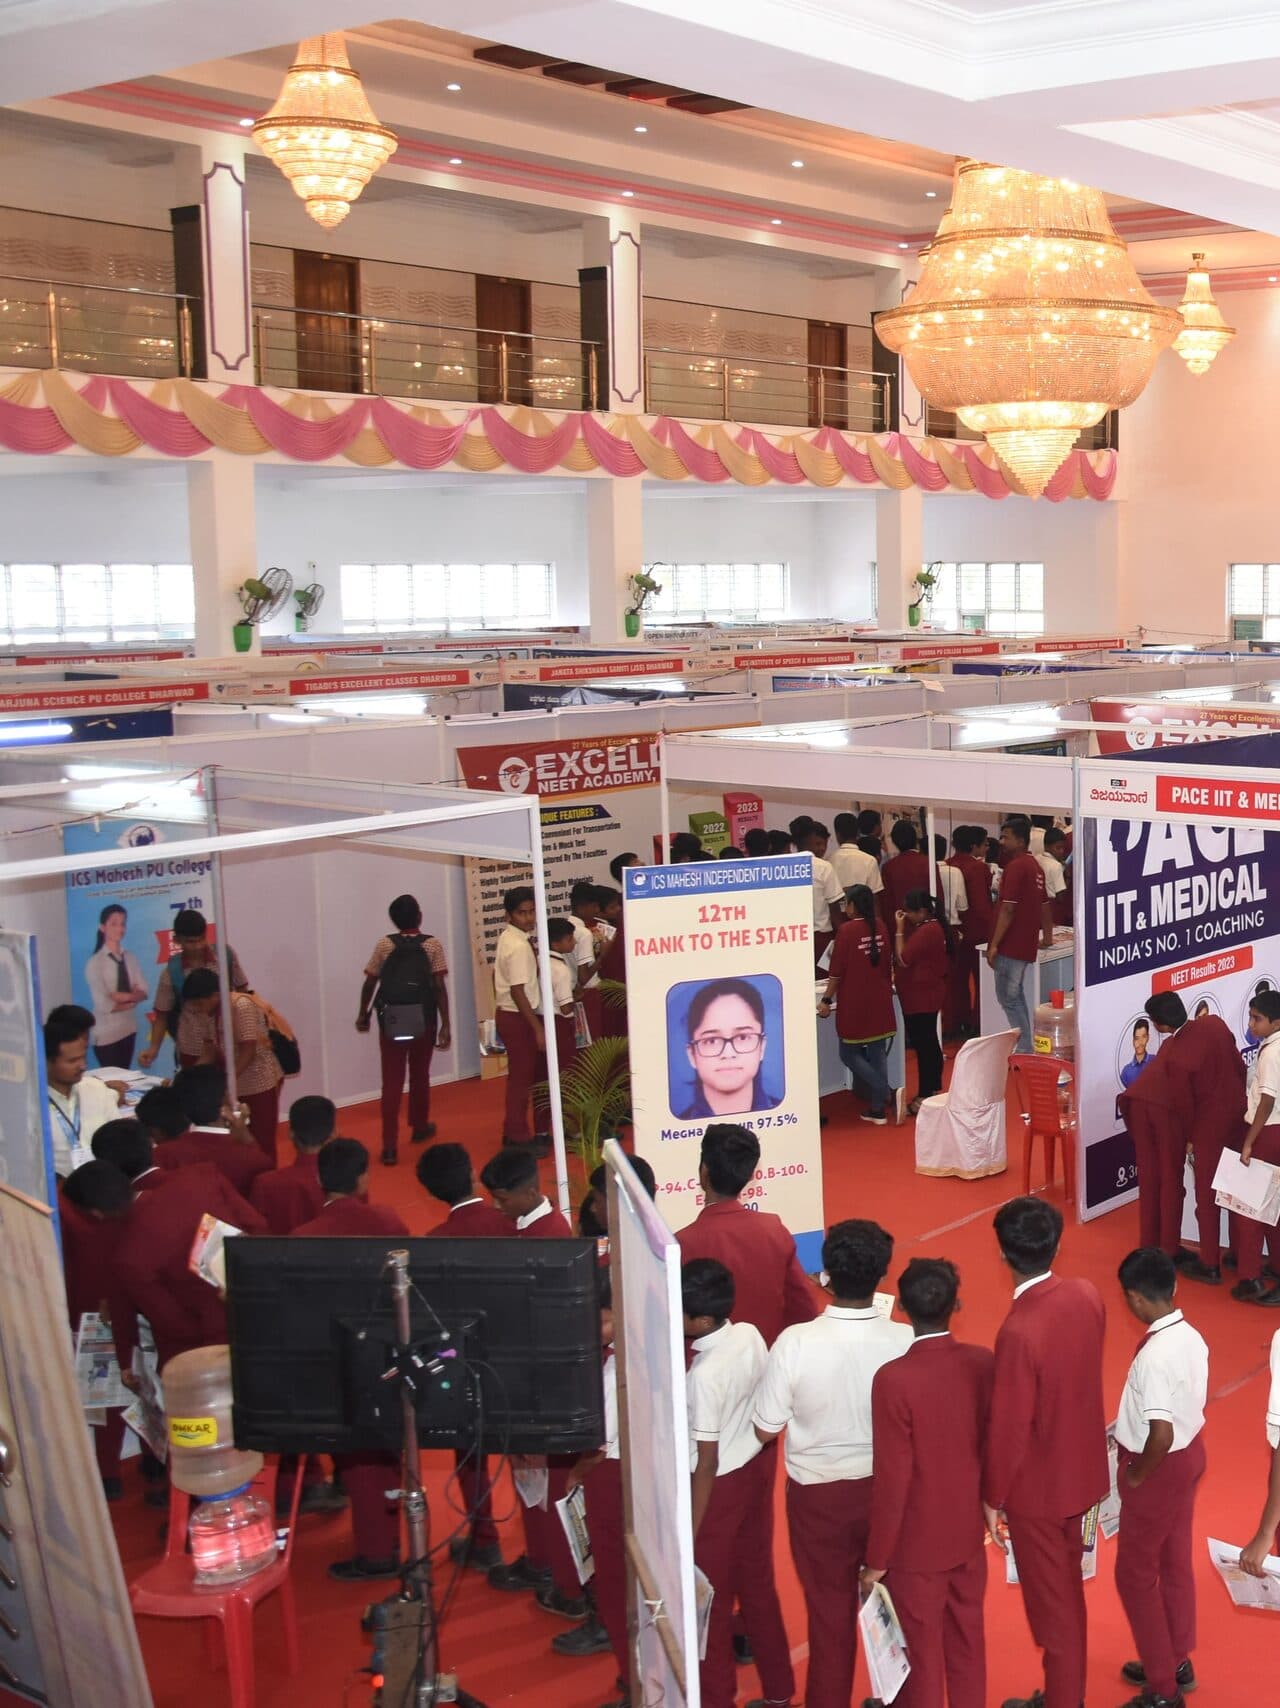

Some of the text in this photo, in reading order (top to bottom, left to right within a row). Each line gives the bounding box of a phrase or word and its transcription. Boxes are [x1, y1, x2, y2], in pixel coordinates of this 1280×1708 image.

[340, 679, 384, 690] EXCELLENT
[385, 676, 418, 686] CLASSES
[420, 674, 457, 684] DHARWAD
[43, 695, 86, 706] SCIENCE
[89, 694, 102, 703] PU
[105, 691, 146, 702] COLLEGE
[149, 688, 194, 699] DHARWAD
[1209, 712, 1228, 721] Years
[1229, 713, 1237, 721] of
[1238, 713, 1276, 724] Excellence
[582, 741, 599, 749] Years
[600, 739, 607, 747] of
[538, 770, 656, 794] NEET ACADEMY,
[1090, 788, 1148, 804] ವಿಜಯವಾಣಿ
[1171, 786, 1208, 805] PACE
[1213, 789, 1234, 807] IIT
[1238, 791, 1249, 809] &
[560, 808, 594, 821] FEATURES
[736, 802, 759, 814] 2023
[573, 827, 582, 836] For
[703, 822, 726, 834] 2022
[575, 839, 586, 847] Test
[564, 853, 571, 862] By
[572, 852, 582, 860] The
[583, 849, 608, 859] Faculties
[71, 858, 213, 888] ICS Mahesh PU College
[651, 863, 811, 890] ICS MAHESH INDEPENDENT PU COLLEGE
[1096, 862, 1267, 940] IIT & MEDICAL
[698, 904, 746, 924] 12TH
[634, 924, 809, 956] RANK TO THE STATE
[1099, 910, 1265, 969] INDIA'S NO. 1 COACHING
[1170, 955, 1236, 986] NEET Results 2023
[757, 1113, 797, 1129] 97.5%
